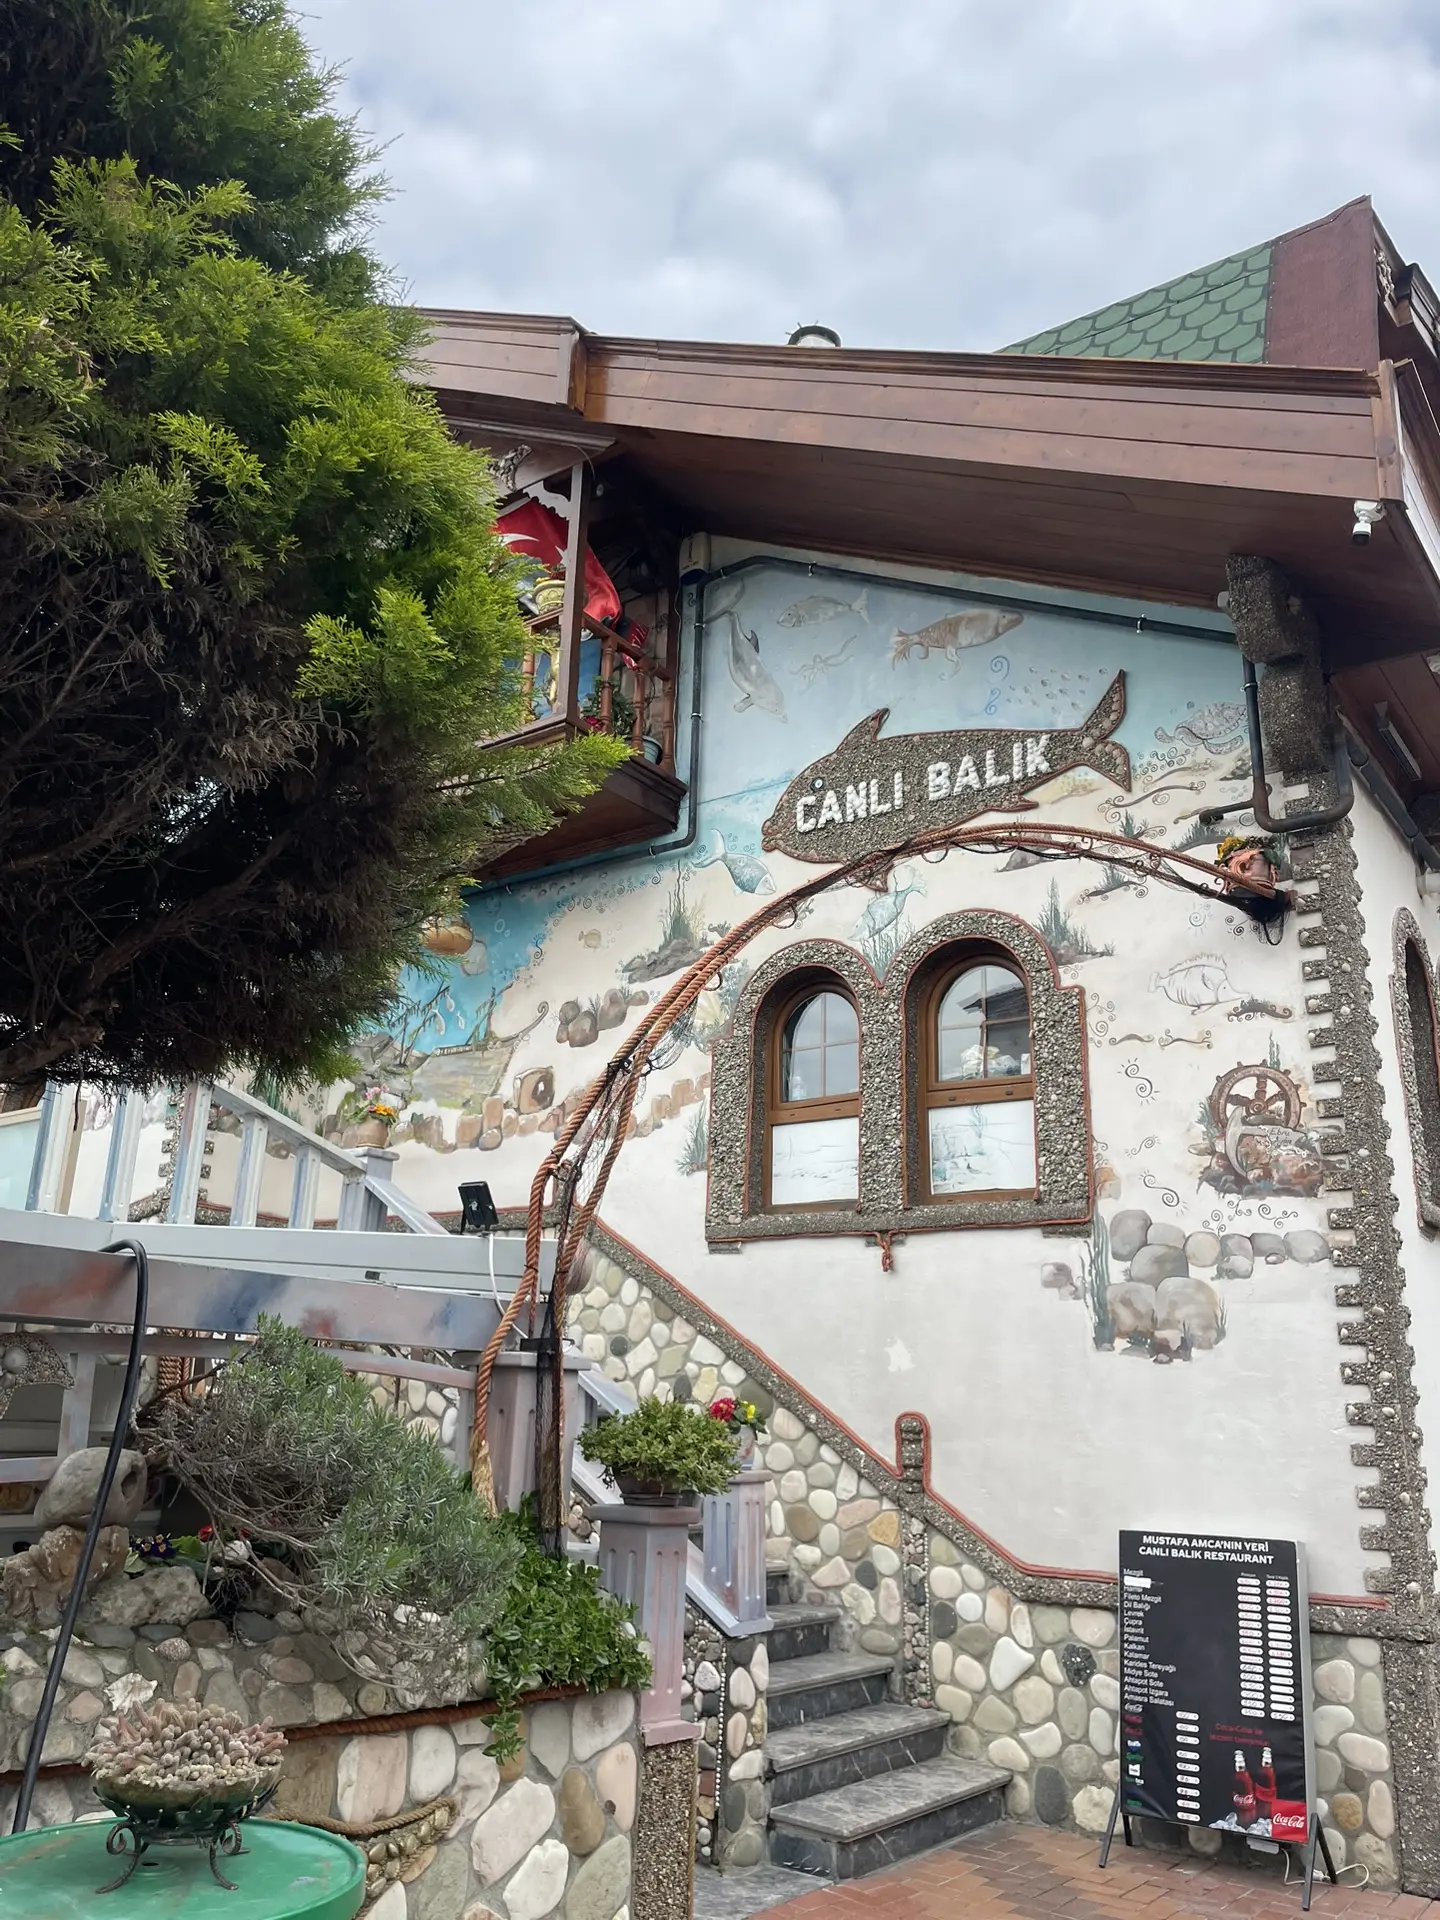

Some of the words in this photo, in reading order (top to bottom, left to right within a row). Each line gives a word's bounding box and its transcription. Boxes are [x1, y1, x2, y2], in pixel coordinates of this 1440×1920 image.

[796, 772, 904, 834] CANLI
[926, 734, 1050, 801] BALIK
[1142, 1535, 1189, 1547] MUSTAFA
[1190, 1538, 1242, 1551] AMCA'NIN
[1243, 1541, 1269, 1553] YERİ
[1138, 1546, 1169, 1557] CANLI
[1170, 1548, 1202, 1560] BALIK
[1203, 1550, 1274, 1565] RESTAURANT
[1123, 1568, 1144, 1577] Mezgit
[1123, 1592, 1140, 1601] Fileto
[1141, 1594, 1162, 1604] Mezgit
[1123, 1600, 1132, 1608] Dil
[1123, 1609, 1145, 1617] Levrek
[1123, 1667, 1143, 1678] Midye
[1143, 1669, 1159, 1679] Sote
[1272, 1812, 1305, 1829] Coca-Cola
